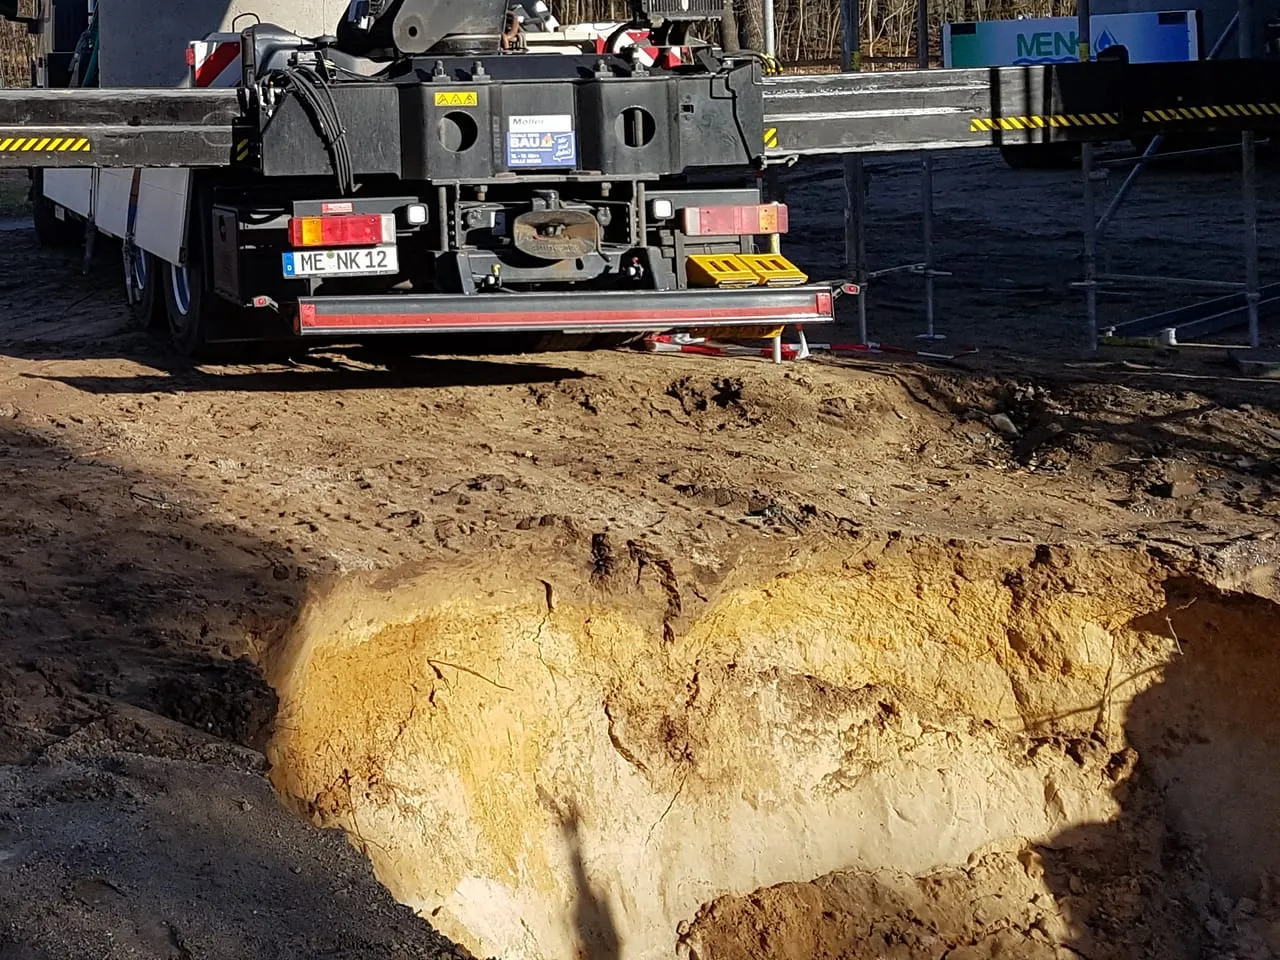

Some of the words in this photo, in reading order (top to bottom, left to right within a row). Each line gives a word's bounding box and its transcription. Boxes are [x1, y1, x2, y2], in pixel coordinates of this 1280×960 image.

[1017, 31, 1080, 57] MEN
[510, 137, 540, 148] BAU
[300, 253, 325, 271] ME
[336, 251, 361, 269] NK
[365, 250, 388, 268] 12
